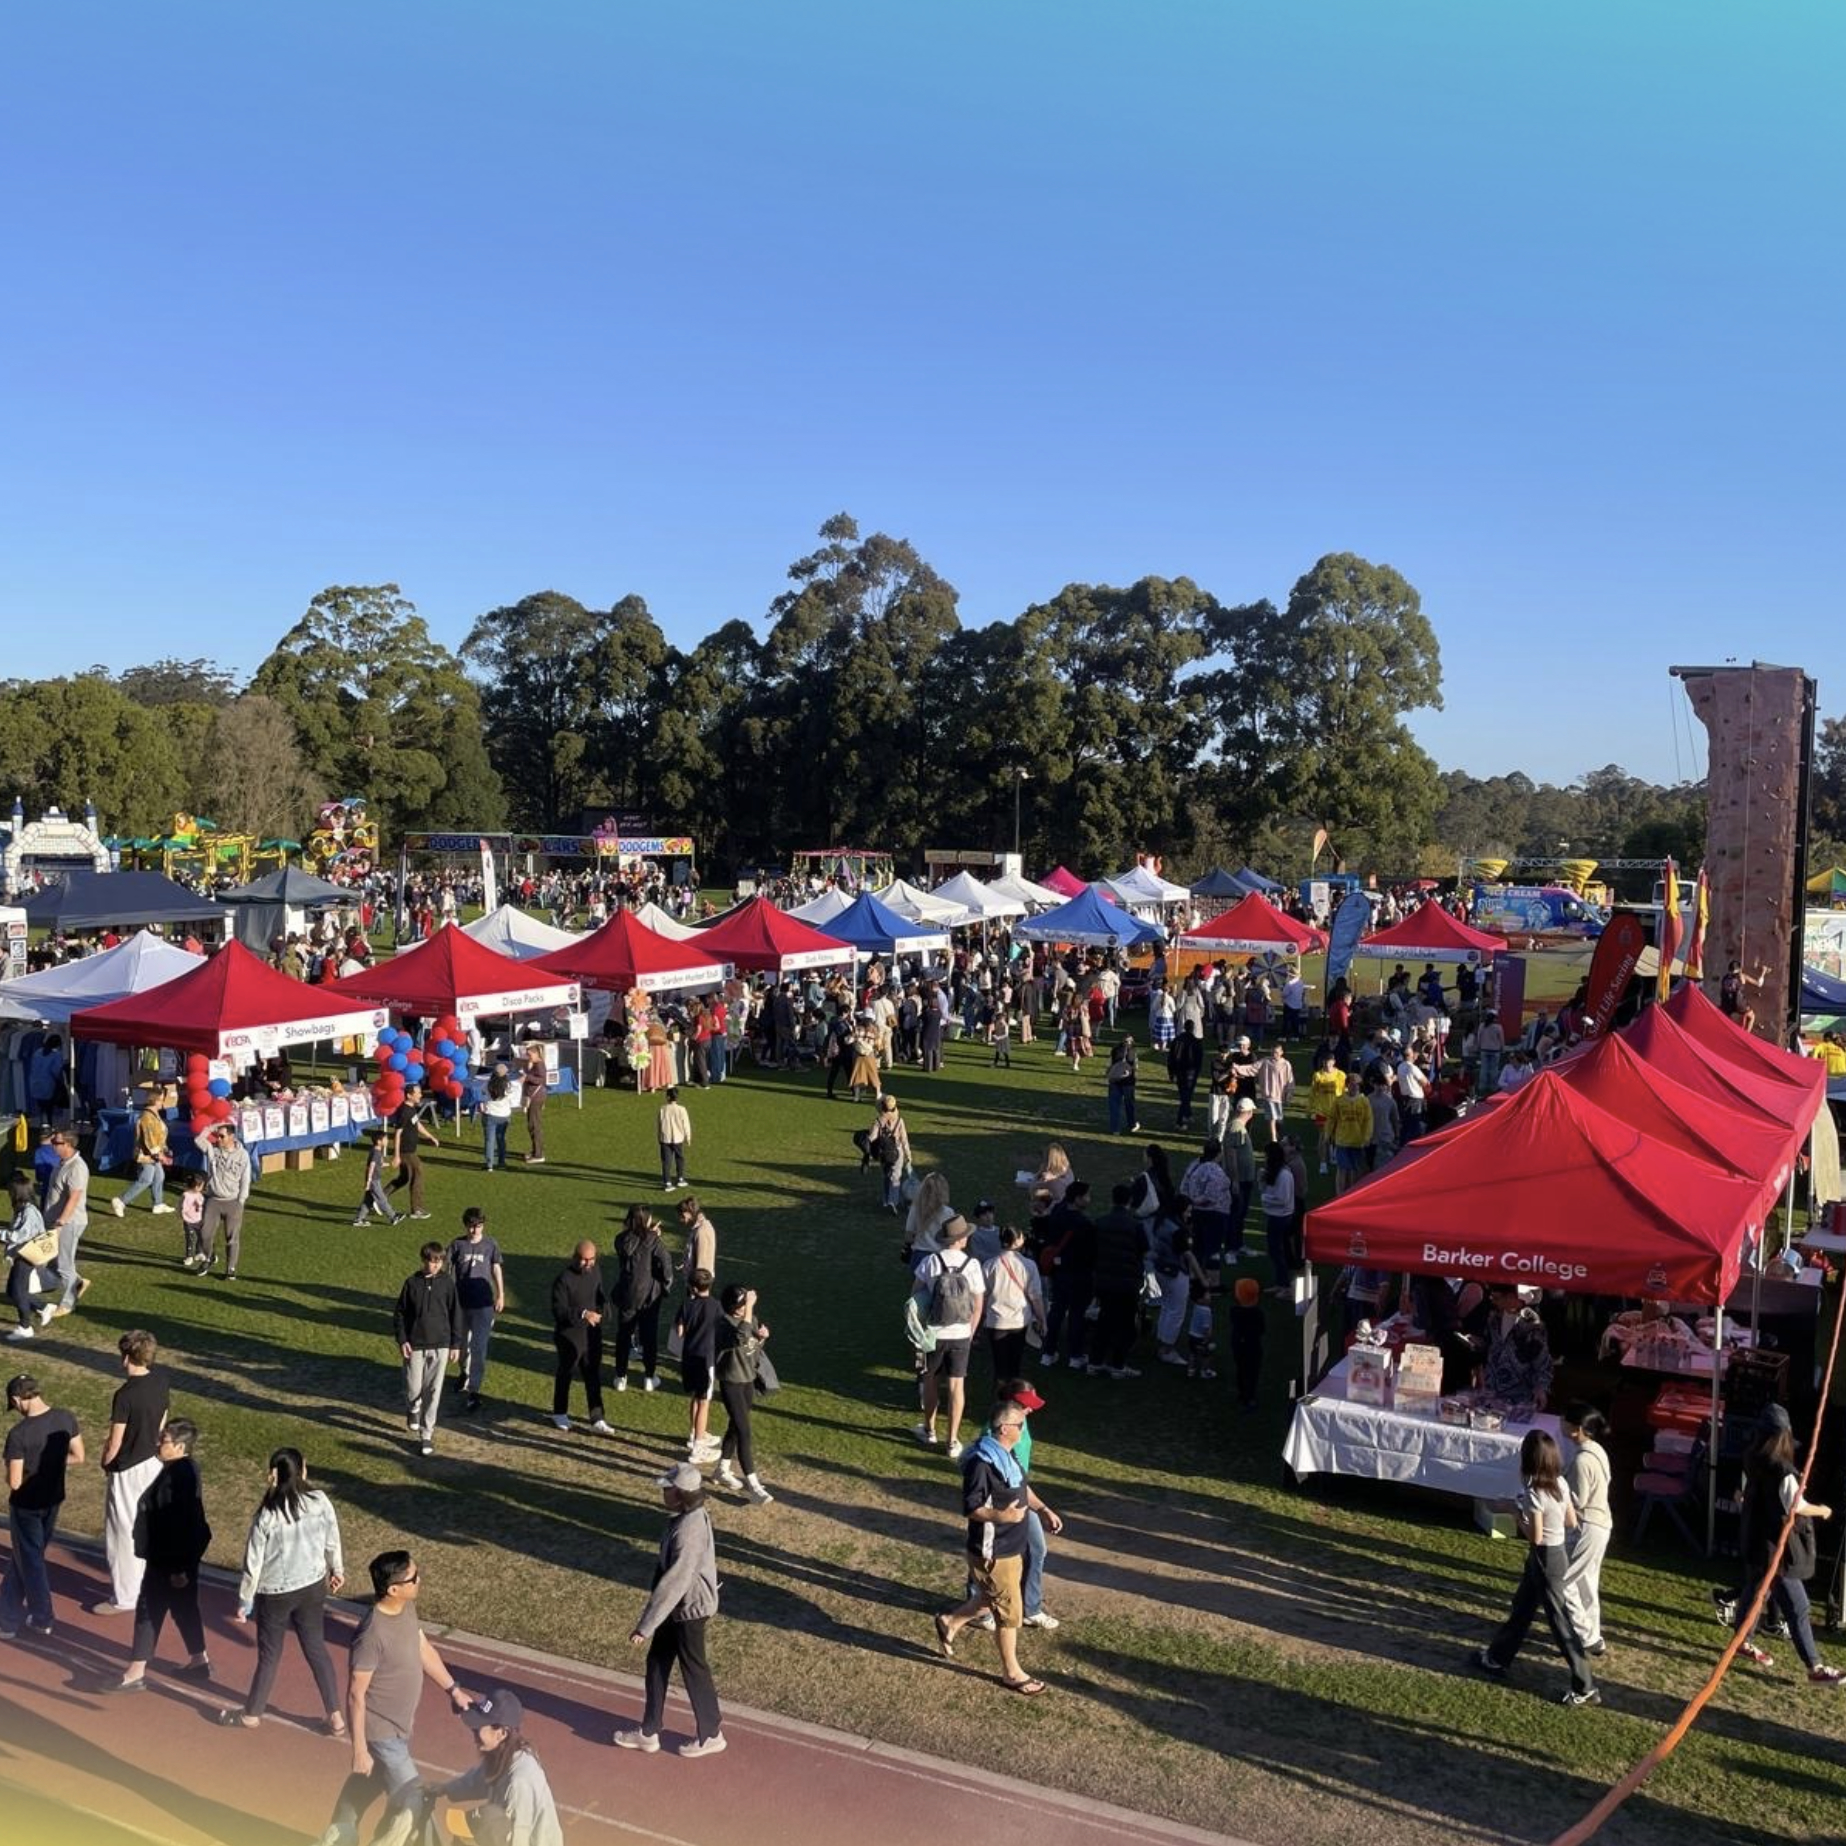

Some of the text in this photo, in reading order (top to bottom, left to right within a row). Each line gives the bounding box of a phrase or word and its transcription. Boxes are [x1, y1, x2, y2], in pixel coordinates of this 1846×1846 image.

[619, 840, 664, 852] DODGEMS
[1507, 889, 1541, 897] CREAM
[1600, 991, 1615, 1013] Life
[1611, 953, 1635, 989] Saving
[382, 997, 413, 1012] College
[502, 993, 545, 1007] Disco Packs
[284, 1022, 336, 1039] Showbags
[1422, 1243, 1588, 1281] Barker College
